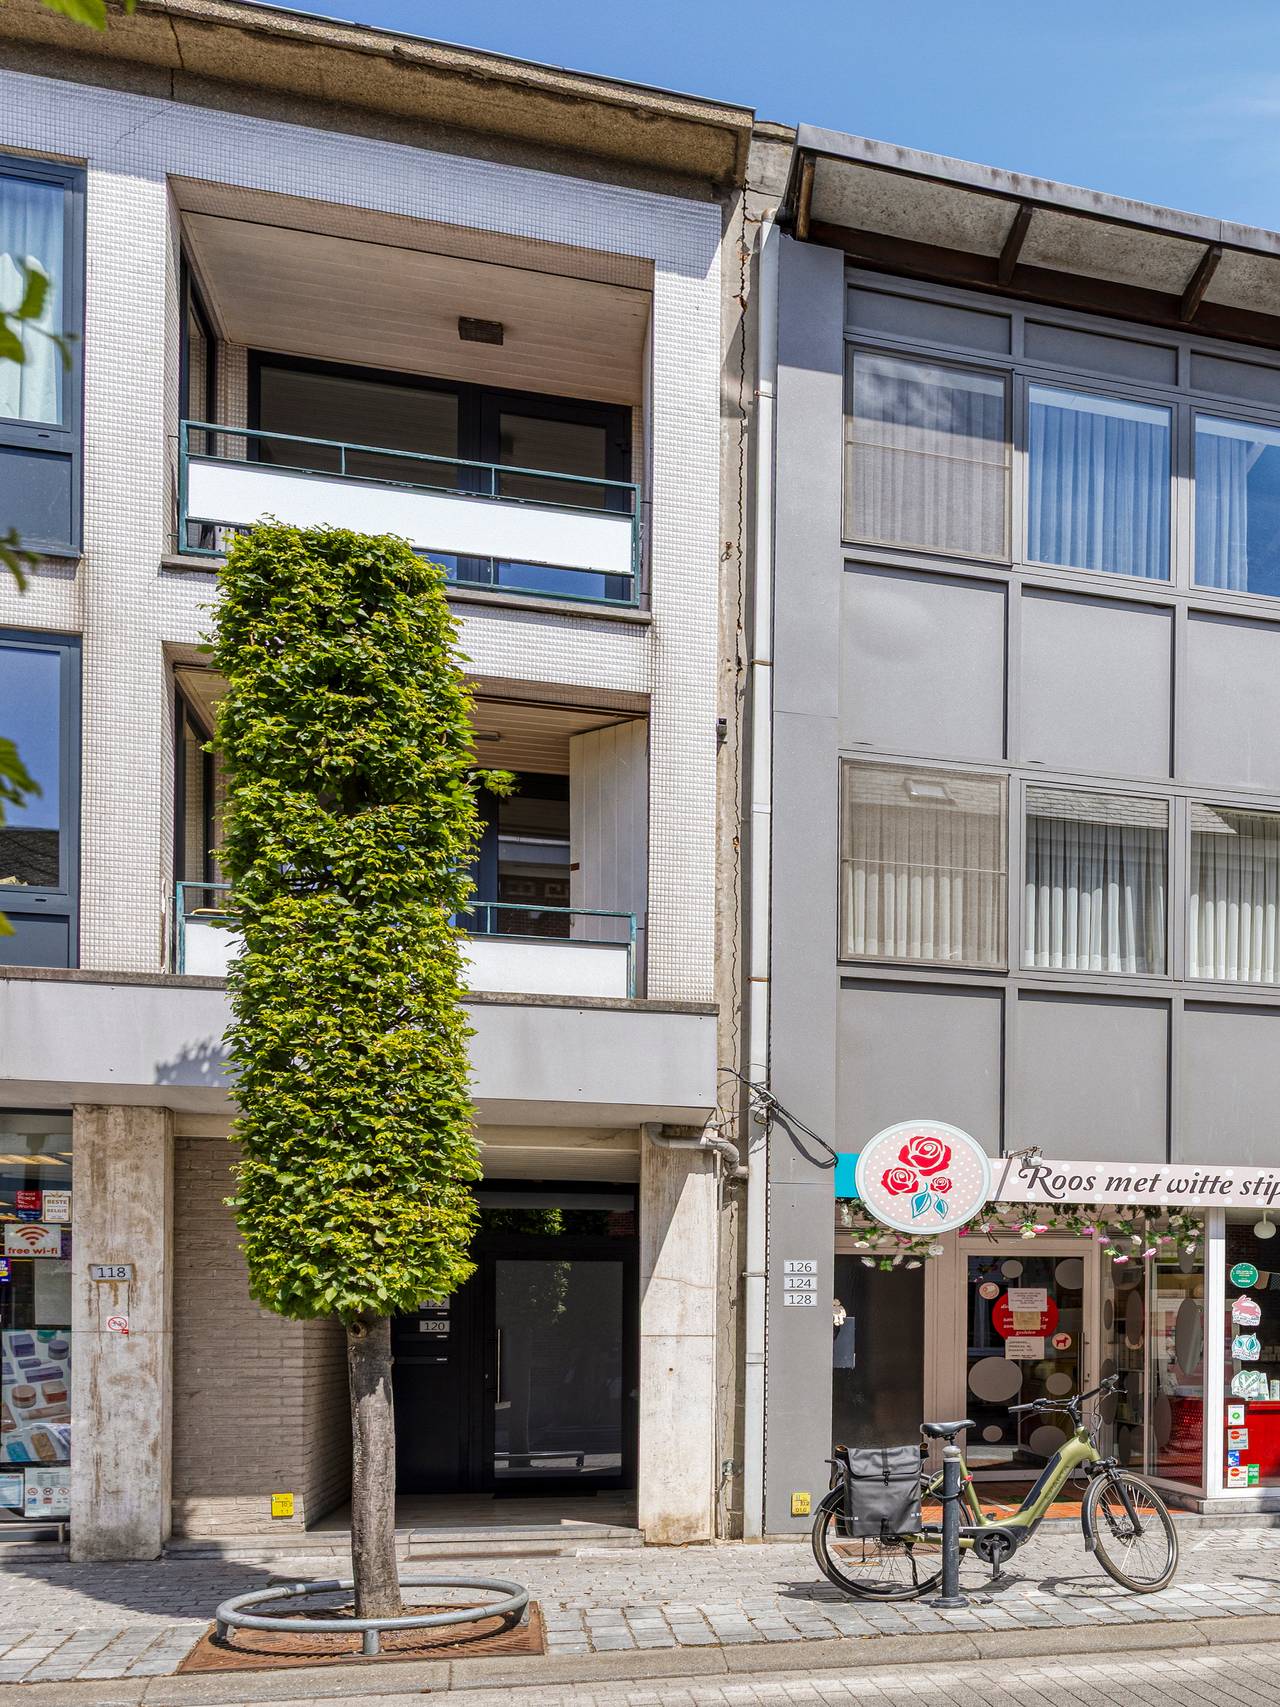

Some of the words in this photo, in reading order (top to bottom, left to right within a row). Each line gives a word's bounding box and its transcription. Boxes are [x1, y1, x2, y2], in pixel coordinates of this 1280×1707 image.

[1018, 1166, 1096, 1199] Roos
[1105, 1173, 1161, 1192] met
[1167, 1172, 1233, 1195] witte
[8, 1247, 30, 1255] free
[33, 1247, 58, 1255] wi-fi
[789, 1262, 812, 1272] 126
[97, 1267, 126, 1278] 118
[789, 1278, 812, 1288] 124
[789, 1294, 812, 1304] 128
[424, 1322, 445, 1331] 120
